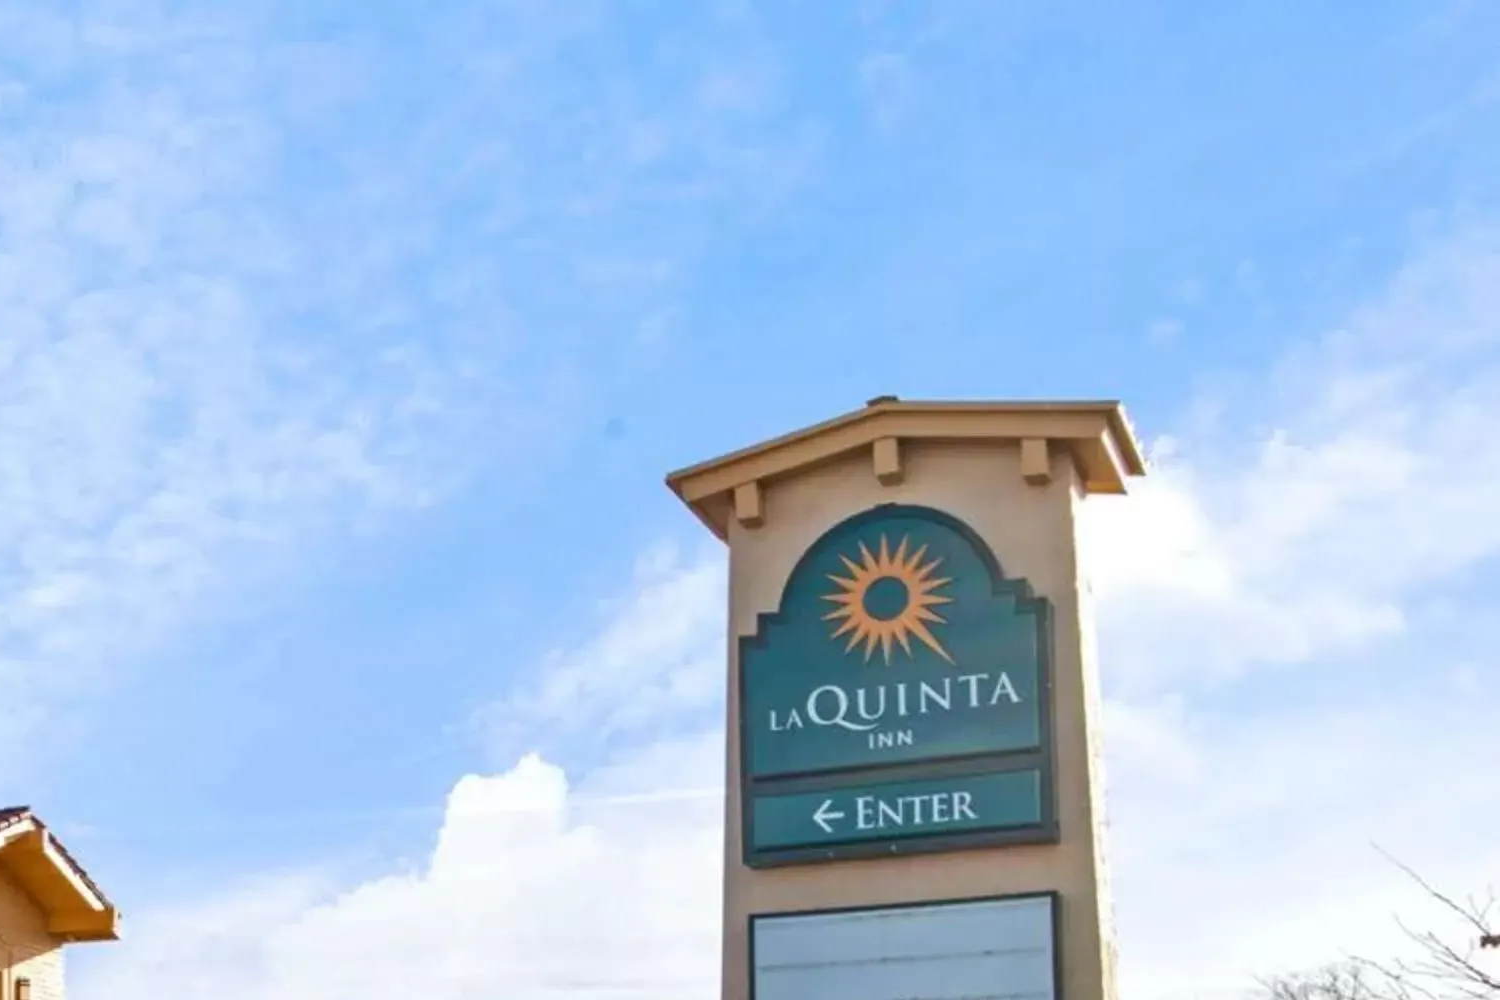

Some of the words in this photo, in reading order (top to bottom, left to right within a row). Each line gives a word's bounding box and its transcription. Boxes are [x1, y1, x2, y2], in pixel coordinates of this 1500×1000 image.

[769, 710, 803, 731] LA
[806, 671, 1023, 731] QUINTA
[868, 729, 913, 750] INN
[855, 791, 978, 830] ENTER
